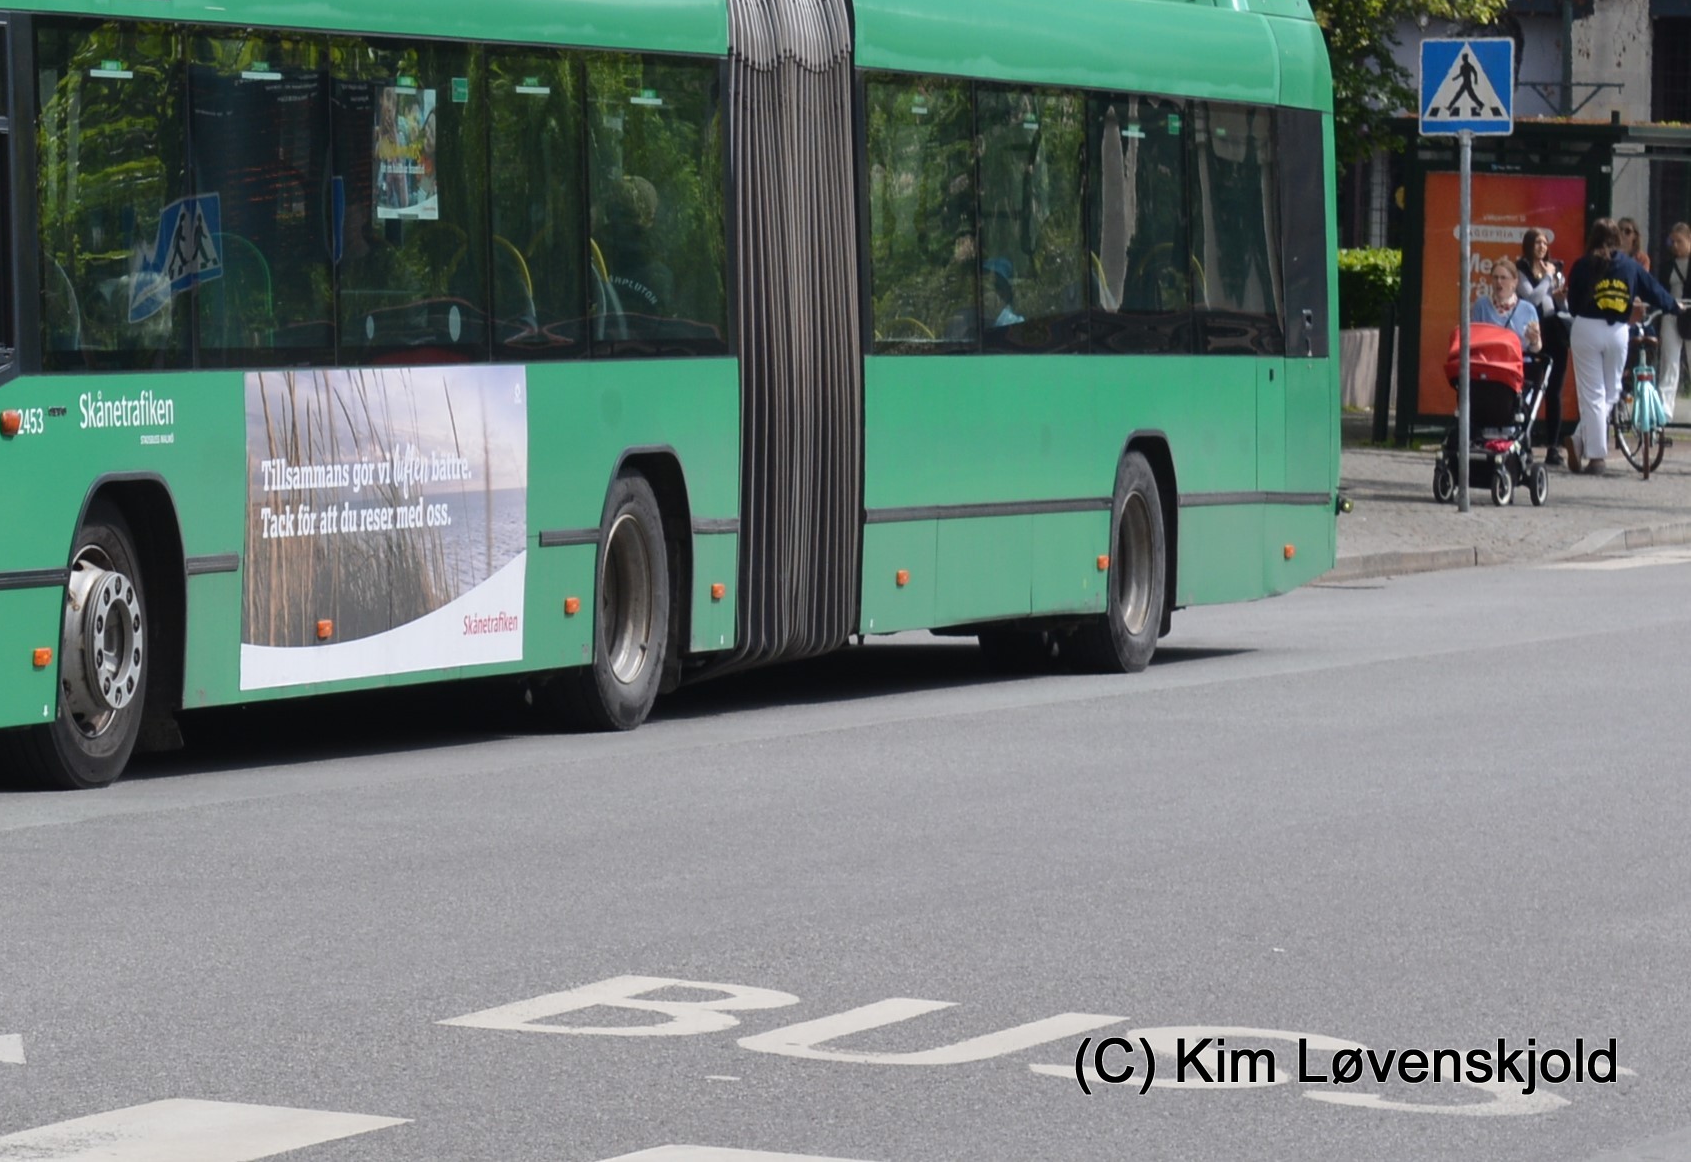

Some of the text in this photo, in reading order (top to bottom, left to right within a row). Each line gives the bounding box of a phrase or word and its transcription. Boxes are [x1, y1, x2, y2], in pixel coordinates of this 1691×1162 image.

[17, 408, 44, 435] 2453
[79, 390, 174, 429] Skånetrafiken
[261, 442, 472, 499] Tillsammans gör vi luften bättre.
[261, 496, 452, 539] Tack för att du reser med oss.
[463, 611, 518, 636] Skånetrafiken
[435, 974, 1637, 1116] BUSS
